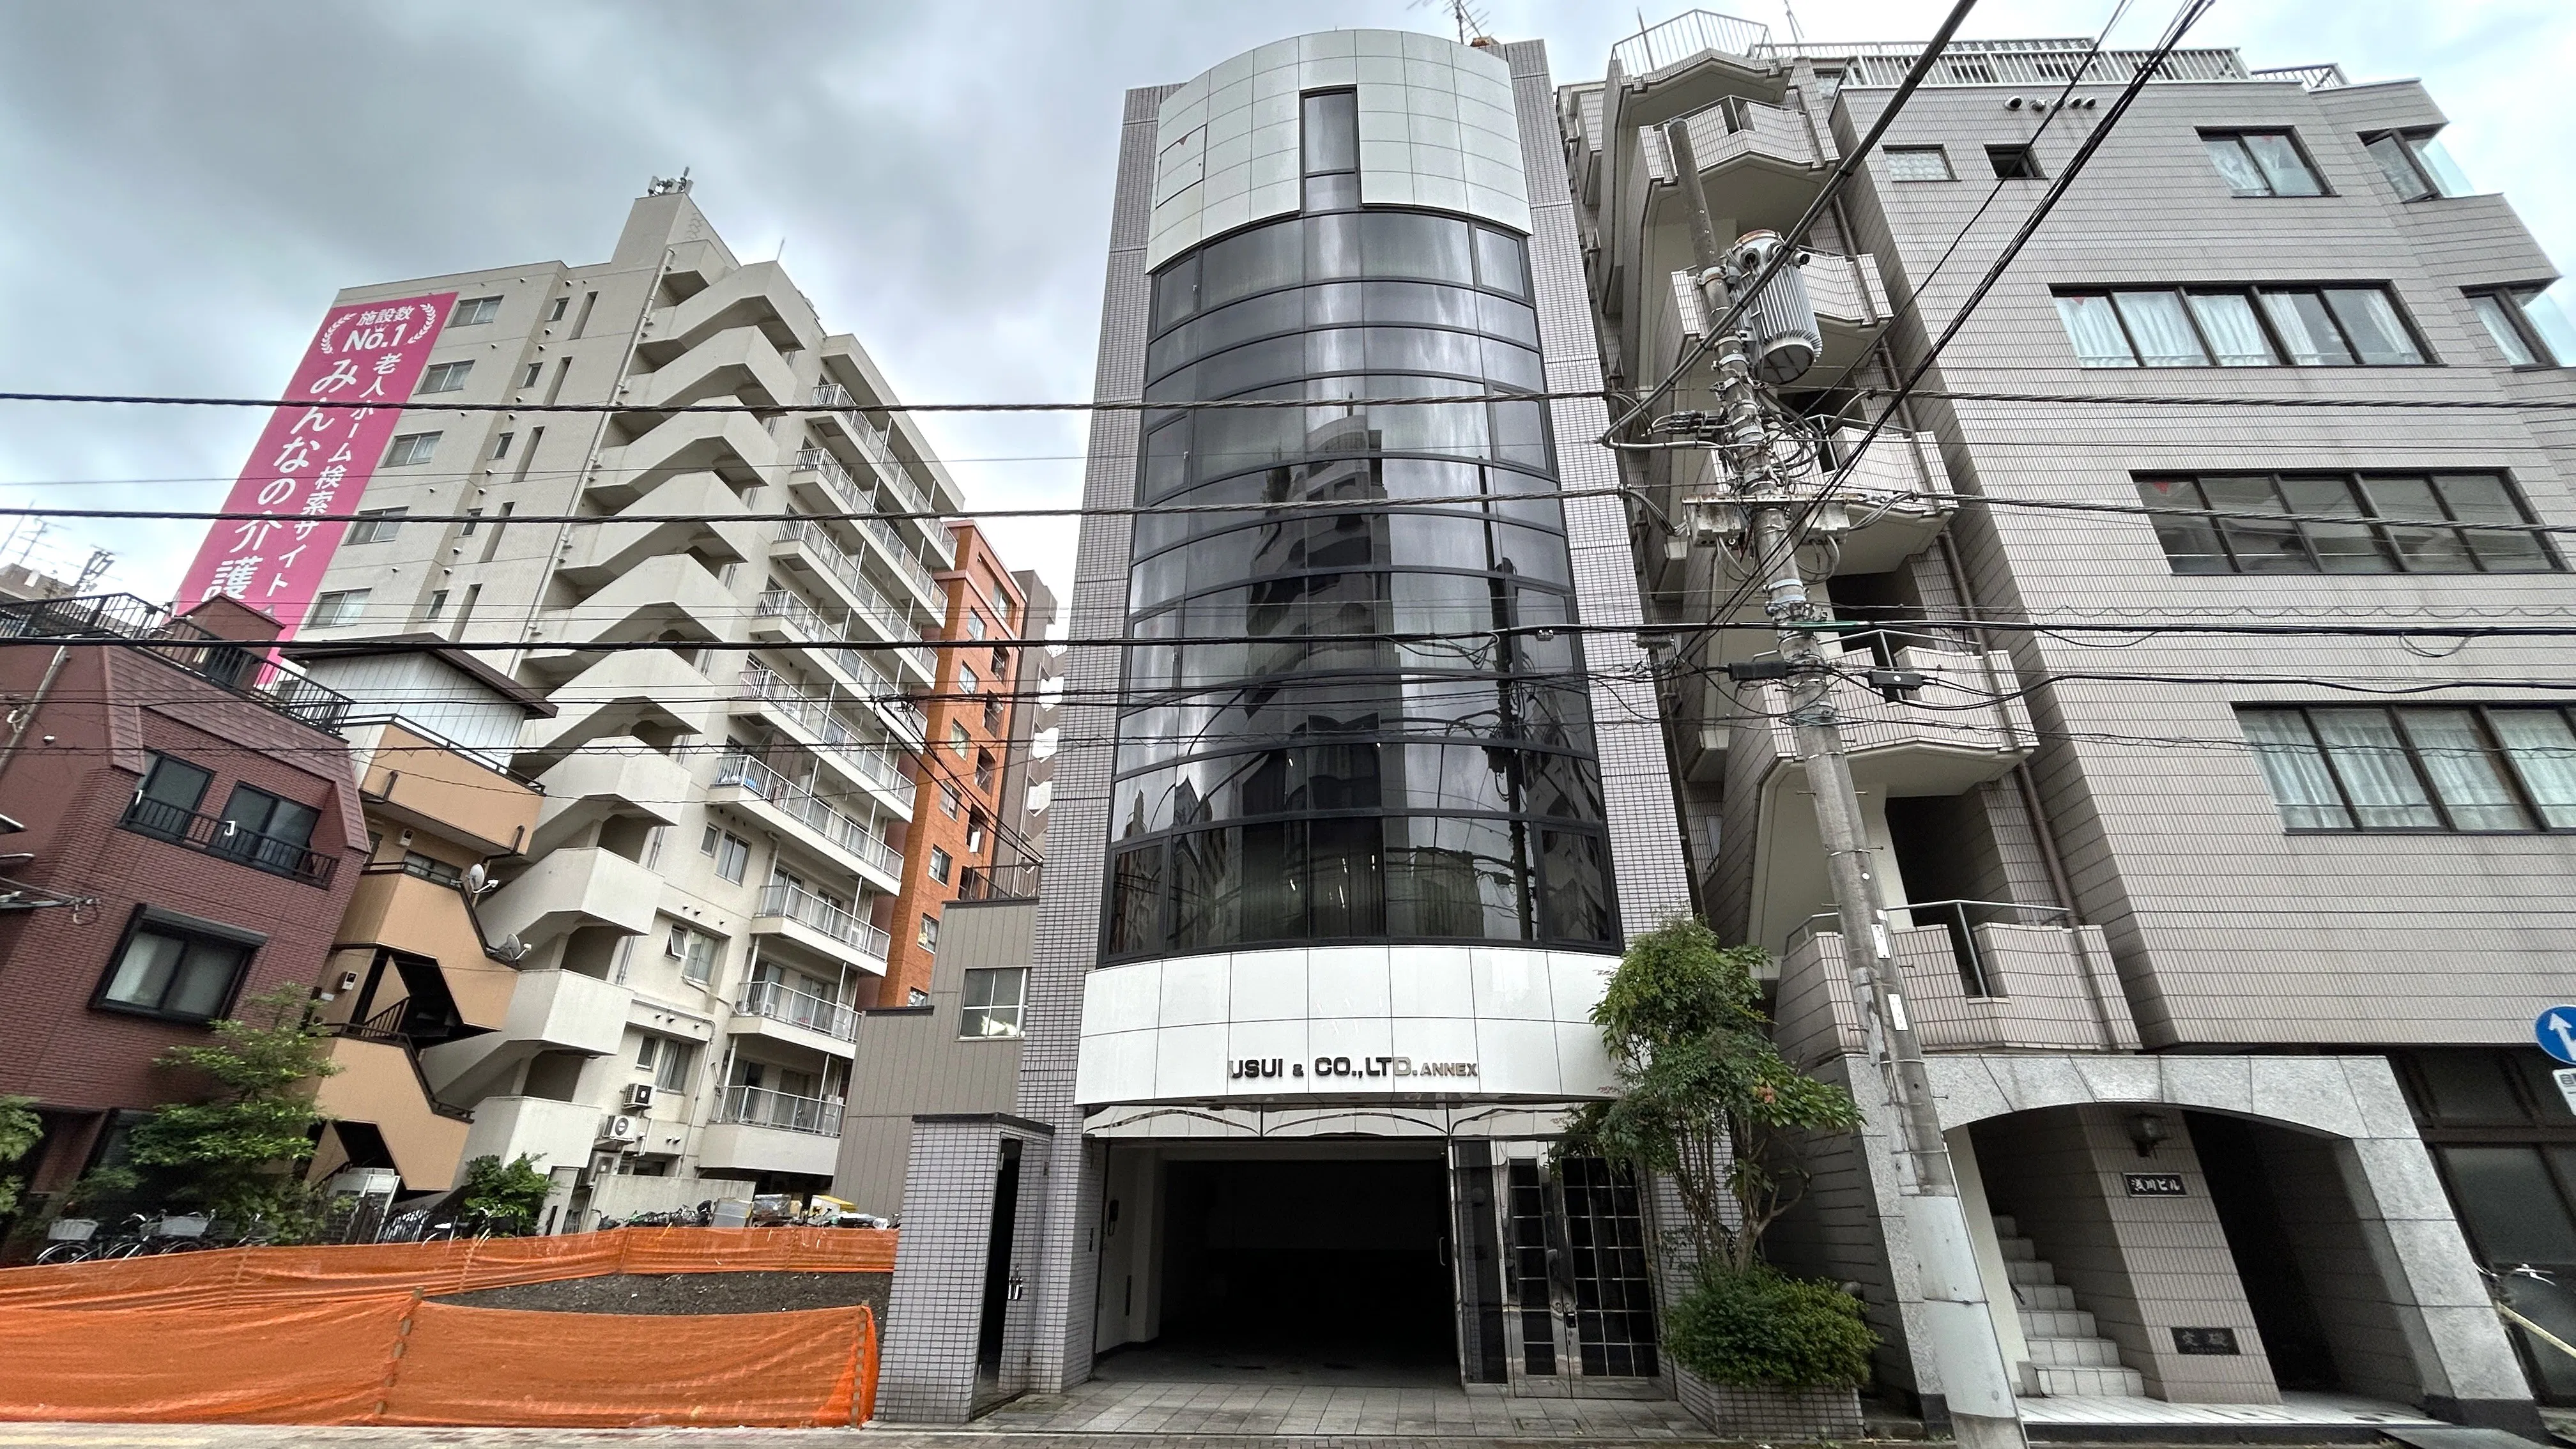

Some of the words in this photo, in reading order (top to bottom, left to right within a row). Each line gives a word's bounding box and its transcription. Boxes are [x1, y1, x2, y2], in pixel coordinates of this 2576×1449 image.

[356, 305, 415, 326] 施設数
[342, 323, 408, 352] No.1
[201, 359, 358, 602] みんなの介護
[266, 353, 402, 597] 老人ホーム検索サイト
[1229, 1058, 1283, 1078] USUI
[1292, 1064, 1304, 1077] &
[1420, 1062, 1478, 1077] ANNEX
